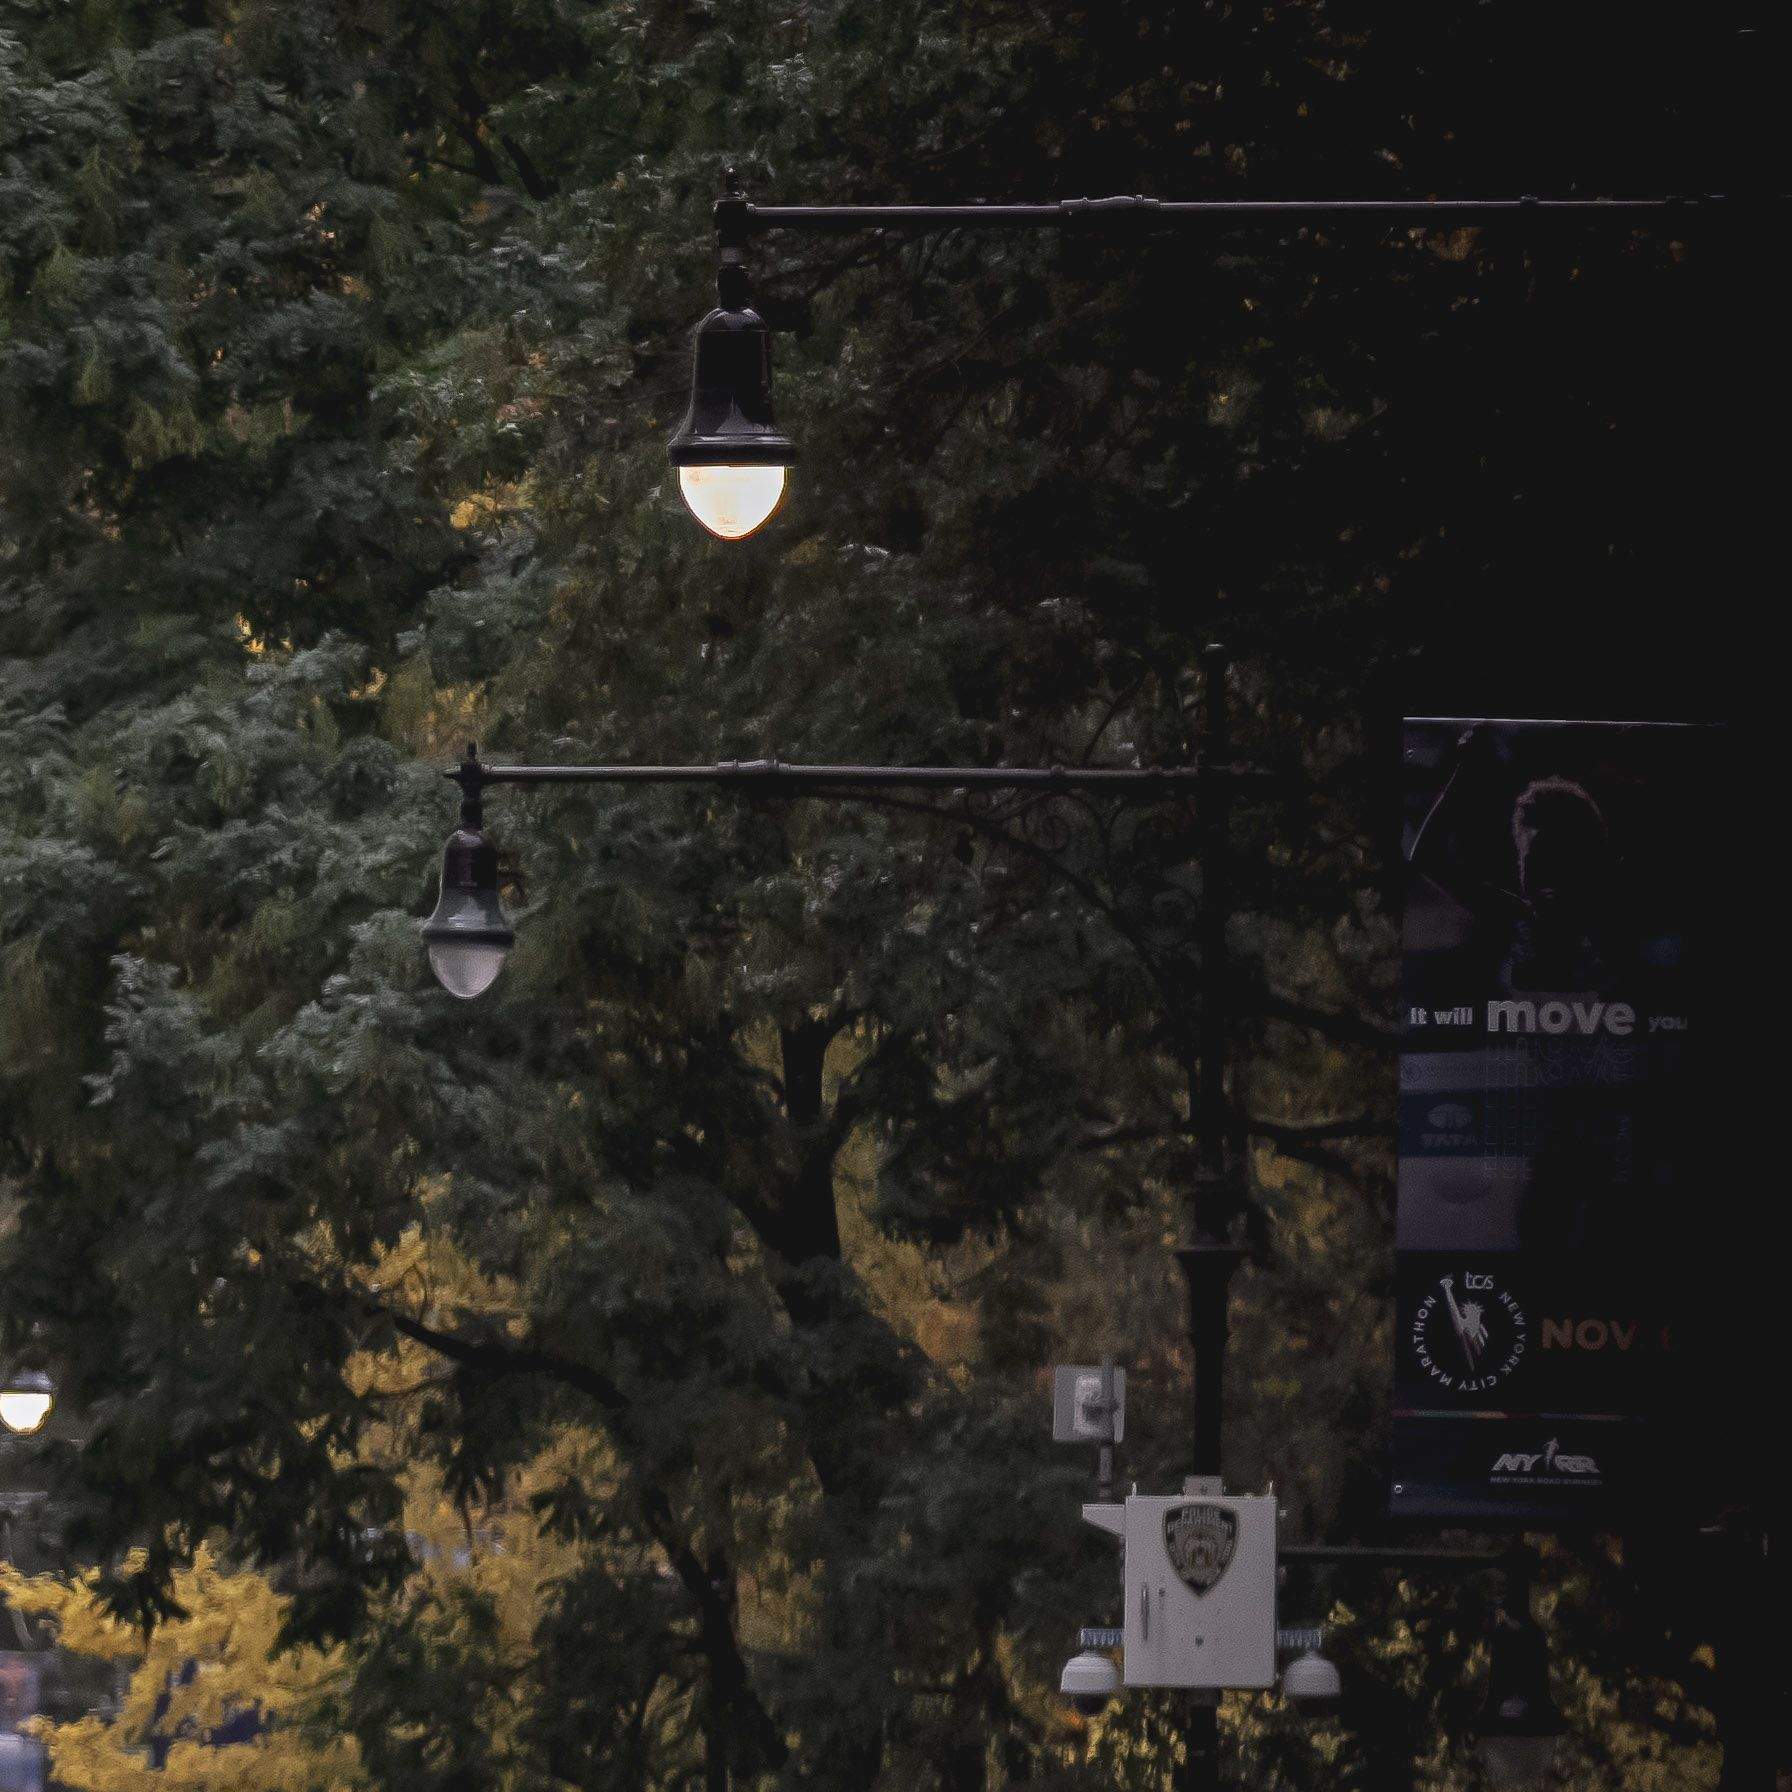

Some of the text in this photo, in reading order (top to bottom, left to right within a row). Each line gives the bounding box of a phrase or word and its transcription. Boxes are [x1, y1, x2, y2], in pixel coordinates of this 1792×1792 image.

[1409, 1000, 1689, 1036] It will move you
[1412, 1292, 1528, 1393] NEW YORK CITY MARATHON
